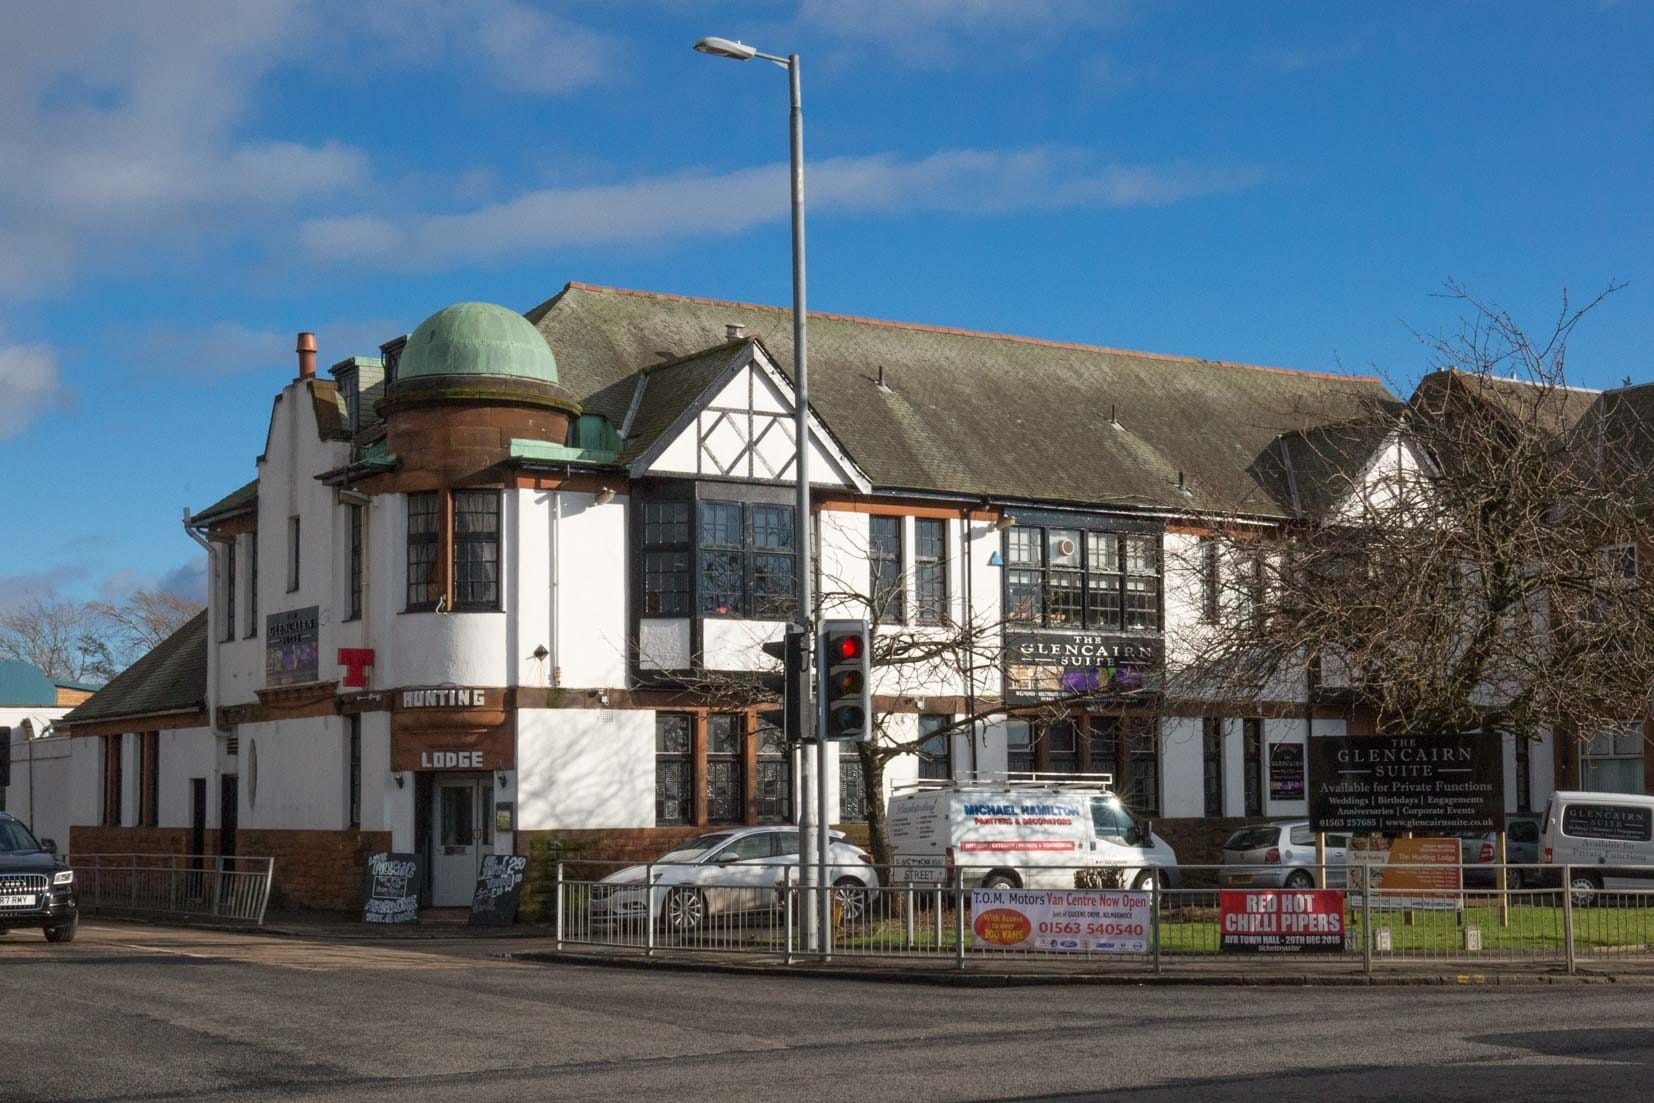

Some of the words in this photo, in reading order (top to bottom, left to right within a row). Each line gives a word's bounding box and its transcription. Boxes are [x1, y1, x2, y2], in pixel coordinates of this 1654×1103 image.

[1073, 635, 1102, 644] THE
[1020, 643, 1152, 658] GLENCAIRN
[1061, 657, 1115, 666] SUITE
[403, 689, 485, 708] HUNTING
[1391, 739, 1416, 747] THE
[421, 751, 483, 768] LODGE
[1337, 747, 1472, 762] GLENCAIRN
[1375, 765, 1433, 777] SUITE
[1320, 782, 1371, 793] Available
[1373, 782, 1388, 793] for
[1391, 781, 1431, 792] Private
[1436, 781, 1493, 792] Functions
[1328, 796, 1369, 806] Weddings
[1377, 795, 1418, 806] Birthdays
[1427, 795, 1484, 806] Engagements
[964, 804, 1019, 816] MICHAEL
[1020, 804, 1080, 816] HAMILTON
[1337, 807, 1394, 816] Anniversaries
[1402, 806, 1445, 817] Corporate
[1447, 806, 1476, 815] Events
[1022, 817, 1073, 826] DECORATORS
[1385, 817, 1494, 829] www.glencairnsuite.co.uk
[904, 870, 935, 880] STREET
[973, 892, 1005, 905] T.O.M.
[1009, 892, 1045, 906] Motors
[1046, 892, 1063, 906] Van
[1066, 893, 1097, 907] Centre
[1099, 894, 1121, 907] Now
[1123, 894, 1147, 911] Open
[1246, 894, 1278, 913] RED
[1281, 894, 1314, 913] HOT
[983, 913, 1000, 922] With
[1225, 913, 1277, 932] CHILLI
[1281, 913, 1340, 932] PIPERS
[1001, 929, 1024, 940] VANS
[1039, 921, 1081, 935] 01563
[1087, 922, 1144, 937] 540540
[1224, 935, 1239, 944] AYR
[1240, 935, 1261, 944] TOWN
[1262, 935, 1281, 944] HALL
[1306, 936, 1321, 944] DEC
